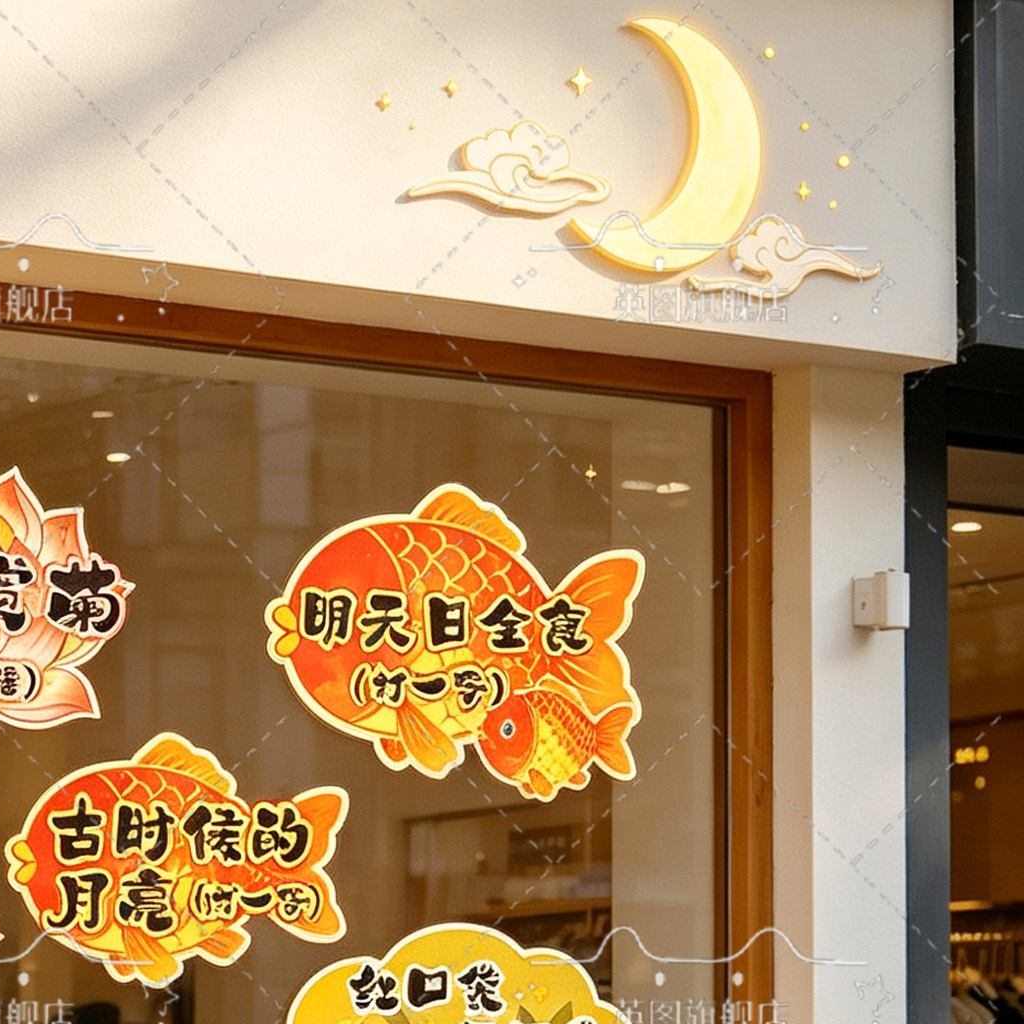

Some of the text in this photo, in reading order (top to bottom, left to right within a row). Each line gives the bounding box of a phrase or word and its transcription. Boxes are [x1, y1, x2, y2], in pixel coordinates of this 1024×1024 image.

[304, 592, 588, 651] 明天日全食
[52, 798, 310, 861] 古时候的
